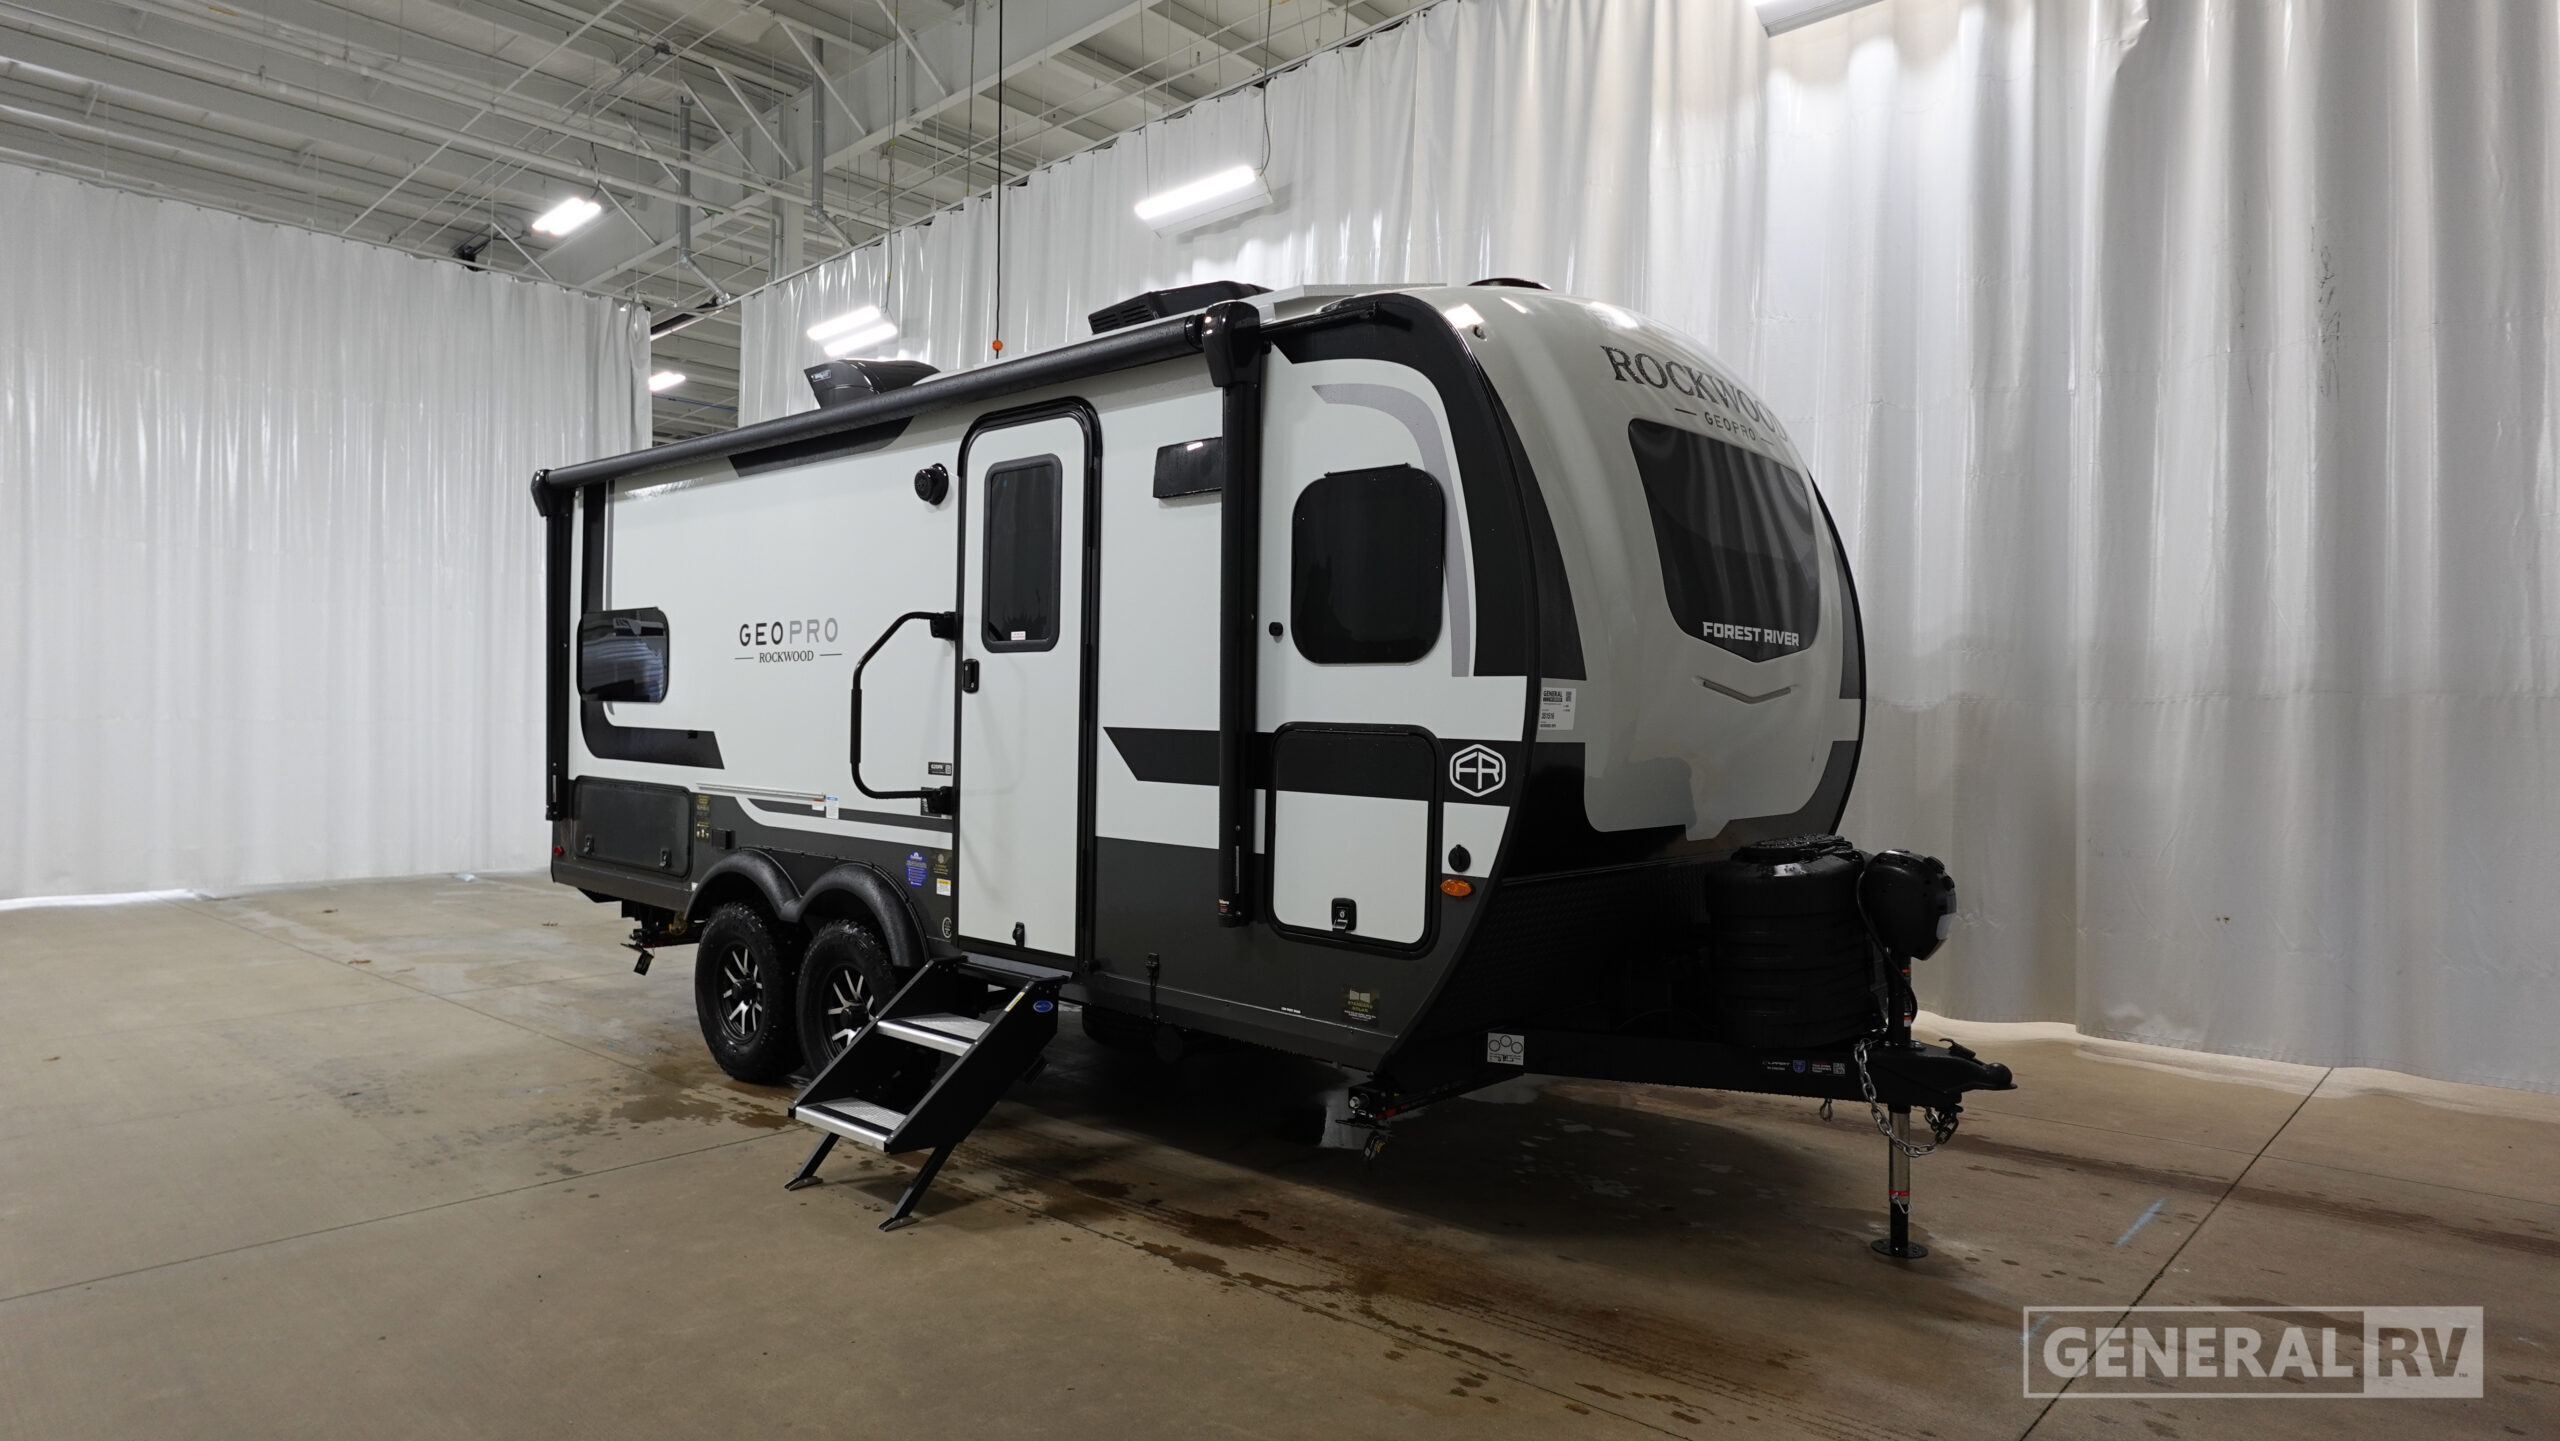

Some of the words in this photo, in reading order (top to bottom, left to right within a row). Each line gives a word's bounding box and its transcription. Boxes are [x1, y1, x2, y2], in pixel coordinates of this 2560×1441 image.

[1600, 345, 1788, 443] ROCKWOOD
[1704, 411, 1757, 442] GEOPRO
[1702, 621, 1762, 642] FOREST
[1763, 628, 1800, 647] RIVER
[759, 650, 814, 663] ROCKWOOD
